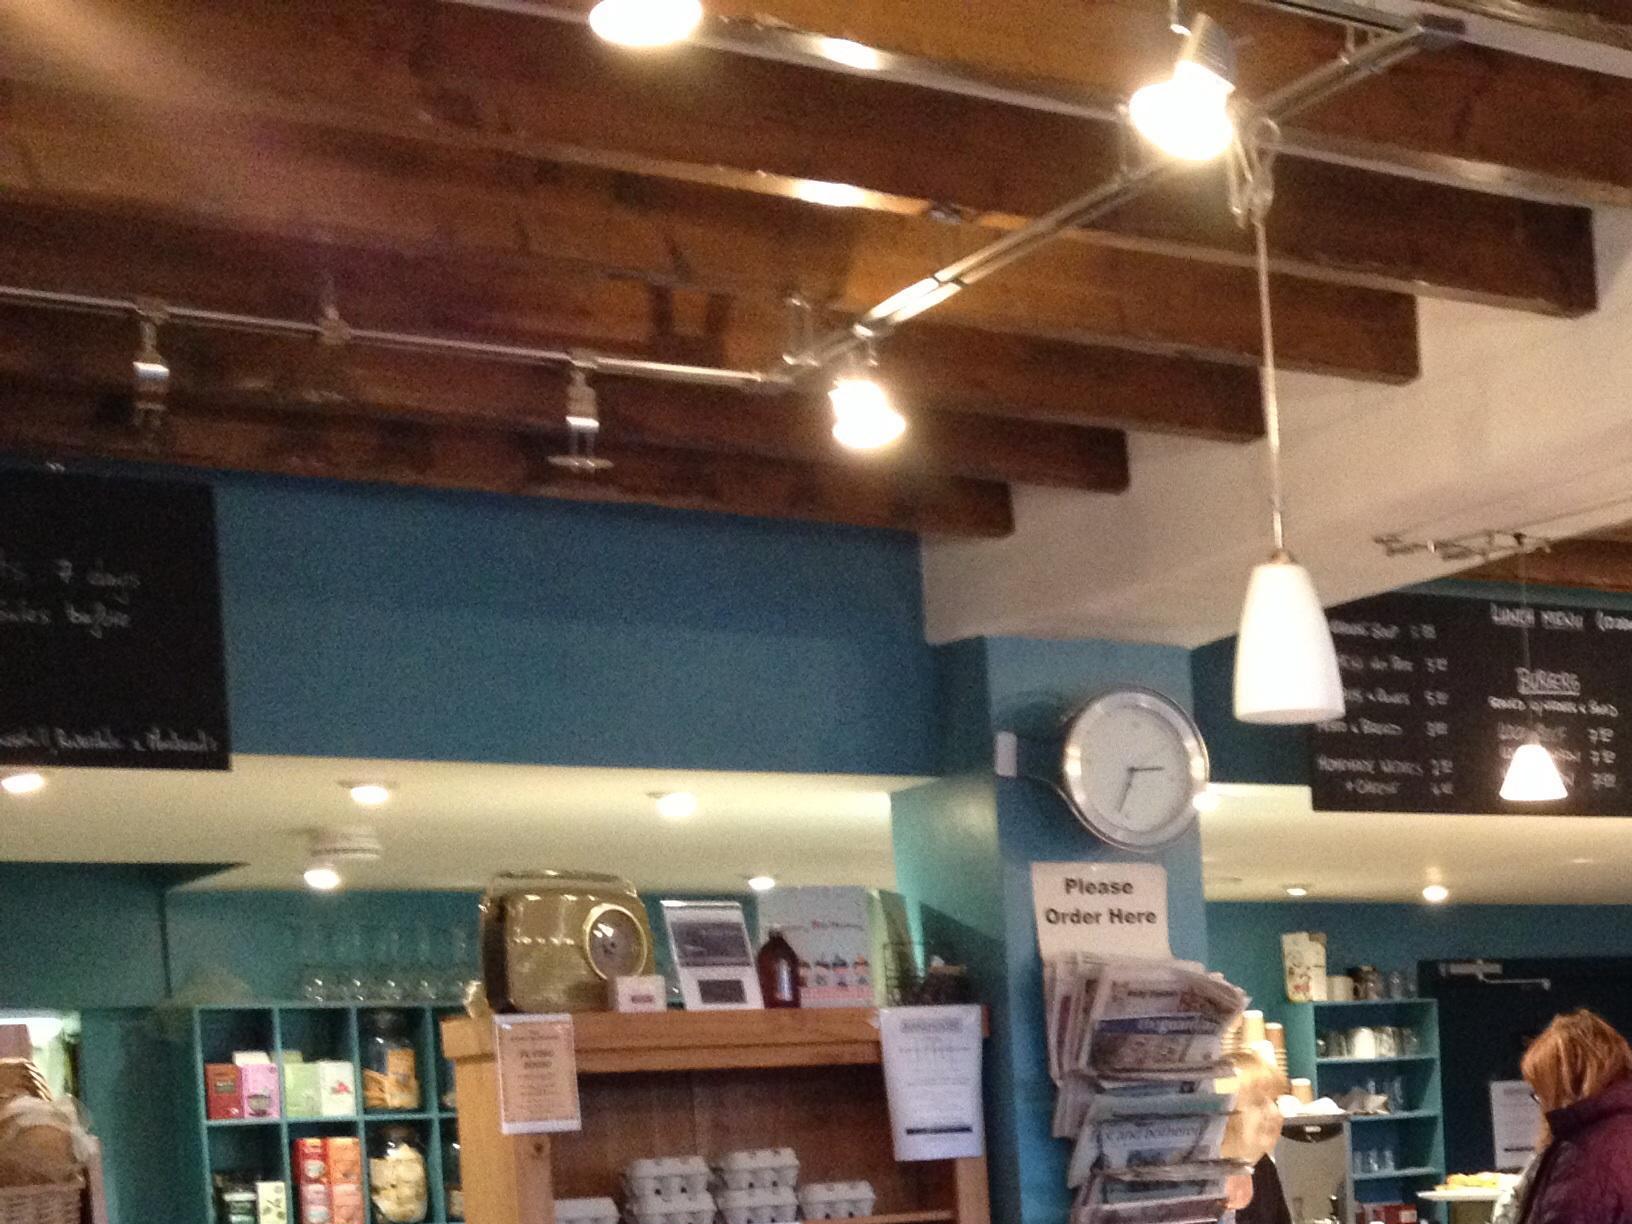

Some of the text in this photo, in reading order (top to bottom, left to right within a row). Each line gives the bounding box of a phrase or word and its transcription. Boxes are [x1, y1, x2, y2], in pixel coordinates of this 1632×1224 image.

[1064, 877, 1134, 895] Please
[1045, 908, 1157, 925] Order Here
